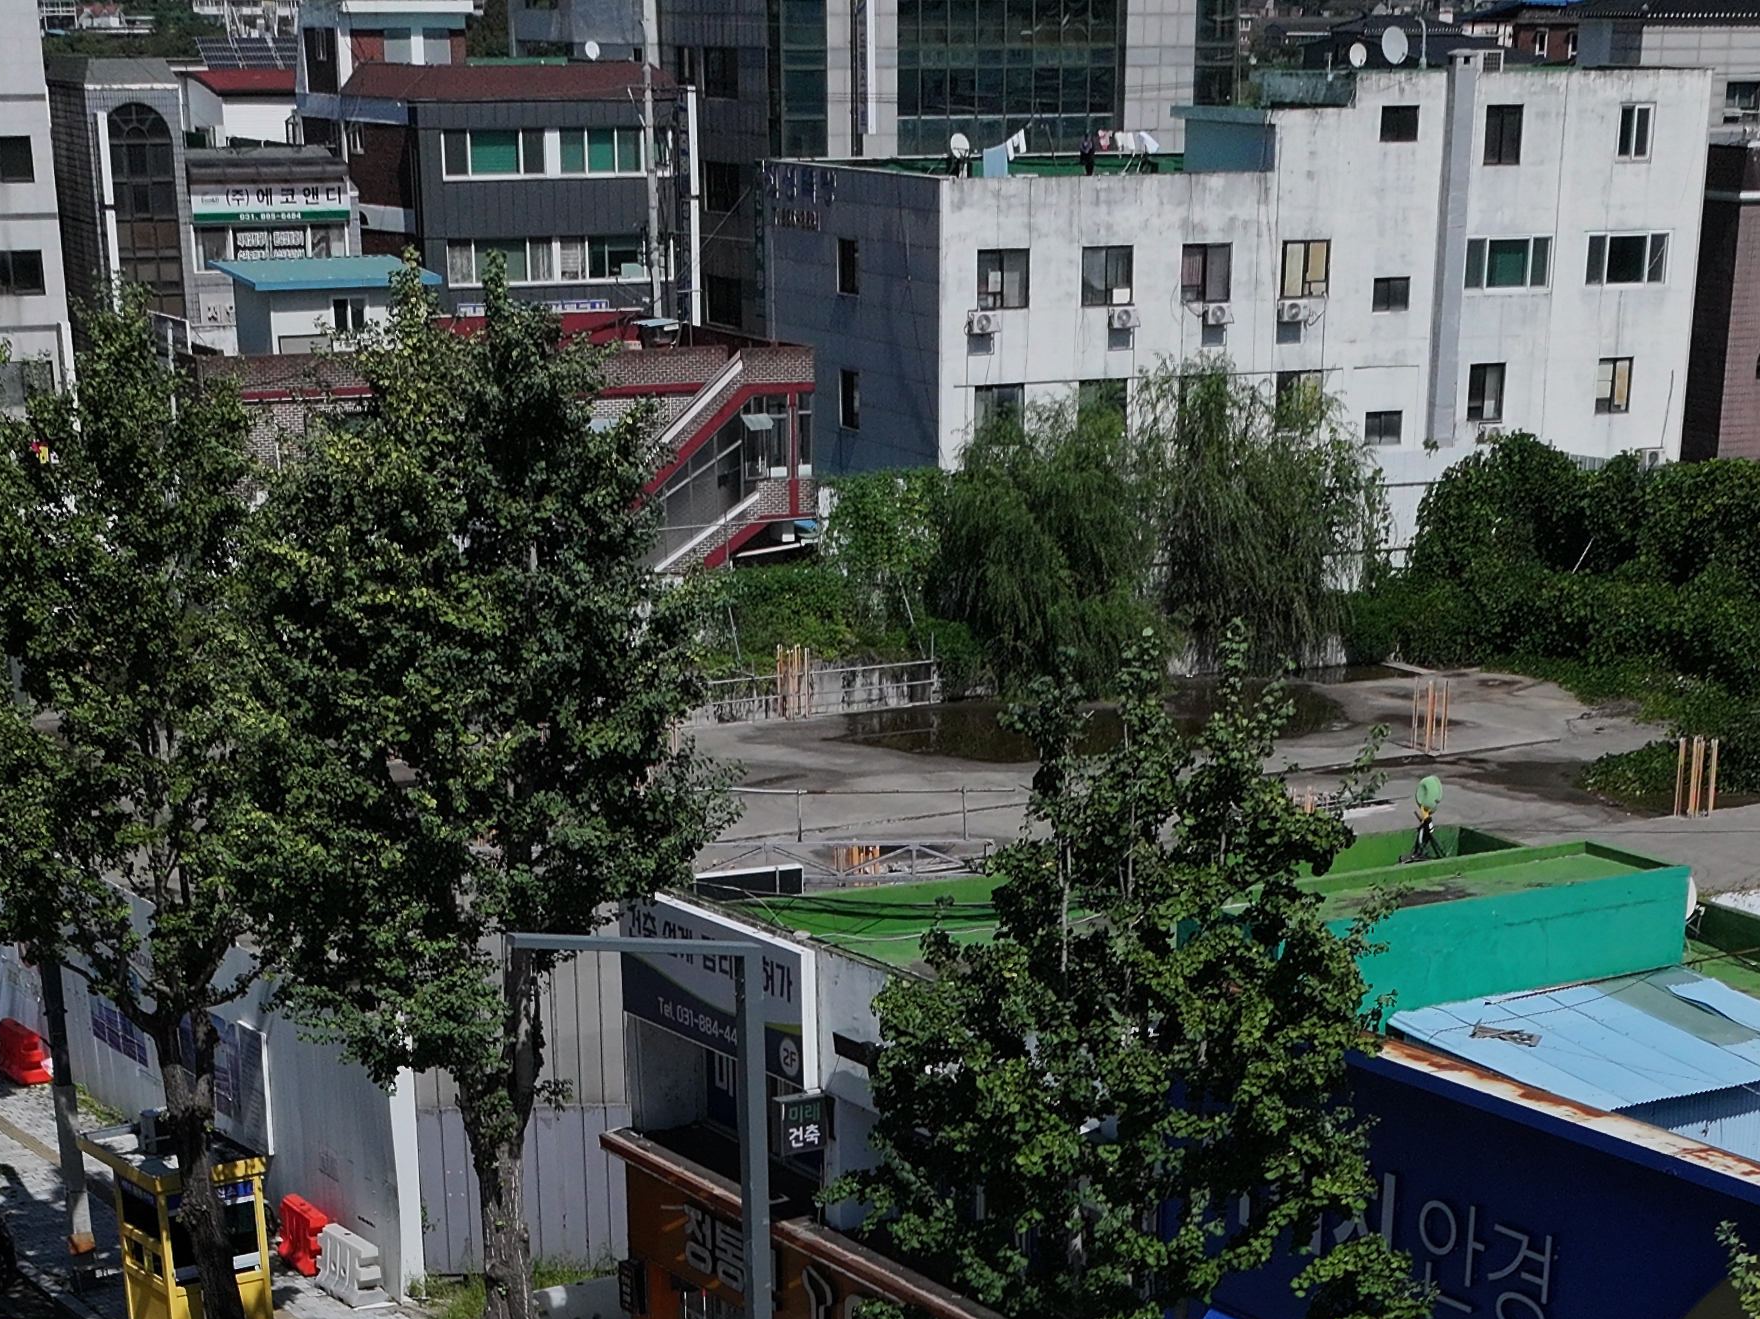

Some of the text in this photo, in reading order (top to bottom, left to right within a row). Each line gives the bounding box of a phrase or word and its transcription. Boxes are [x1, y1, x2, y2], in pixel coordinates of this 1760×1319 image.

[225, 187, 250, 207] (주)
[677, 1004, 737, 1047] 031-884-44
[782, 1050, 798, 1070] 2F
[789, 1103, 821, 1123] 미래
[789, 1124, 821, 1148] 건축
